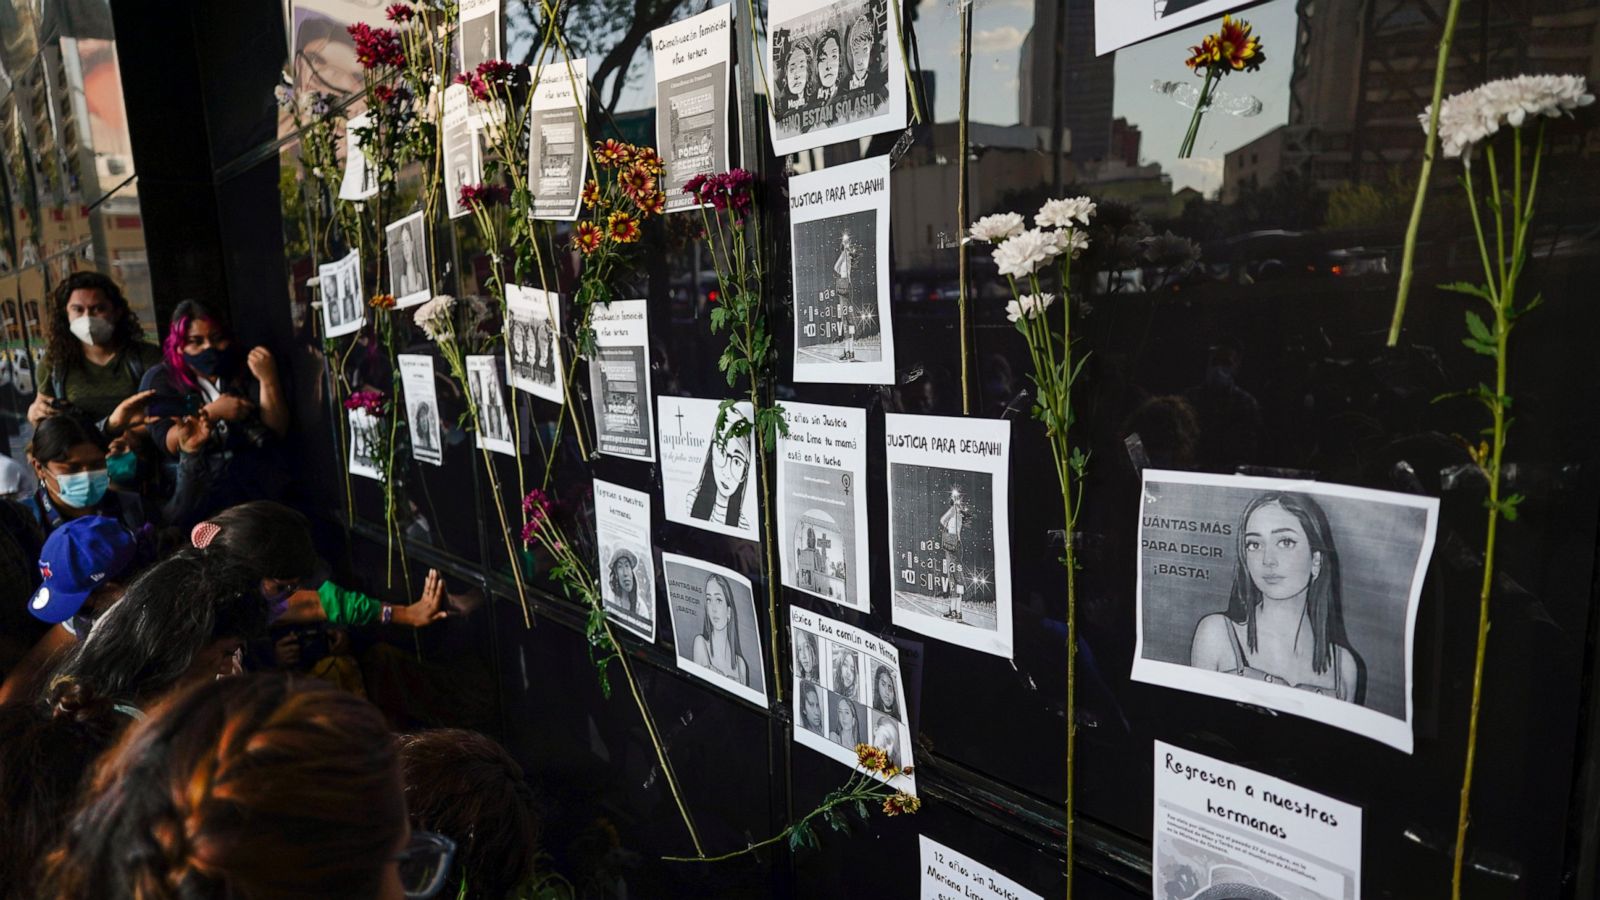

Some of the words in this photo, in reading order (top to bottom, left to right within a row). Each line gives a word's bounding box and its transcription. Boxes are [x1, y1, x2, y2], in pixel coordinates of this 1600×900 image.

[802, 102, 833, 127] ESTÁN
[790, 190, 823, 209] JUSTICIA
[826, 185, 846, 201] PARA
[849, 178, 884, 198] DEBANHI
[820, 321, 855, 338] SIRVE
[825, 436, 832, 446] tu
[887, 434, 927, 452] JUSTICIA
[932, 438, 956, 454] PARA
[960, 439, 1002, 456] DEBANHI
[1142, 516, 1197, 532] UÁNTAS
[1200, 521, 1232, 536] MÁS
[1141, 540, 1178, 553] PARA
[1181, 544, 1223, 558] DECIR
[1153, 564, 1209, 580] ¡BASTA!
[920, 573, 964, 594] SIRVE
[836, 629, 862, 645] común
[865, 640, 877, 651] con
[1166, 753, 1236, 791] Regresen
[1245, 785, 1254, 796] a
[1263, 792, 1338, 827] nuestras
[1207, 798, 1287, 839] hermanas
[927, 865, 961, 893] Mariana
[934, 851, 944, 864] 12
[949, 860, 969, 877] años
[973, 873, 984, 885] sin
